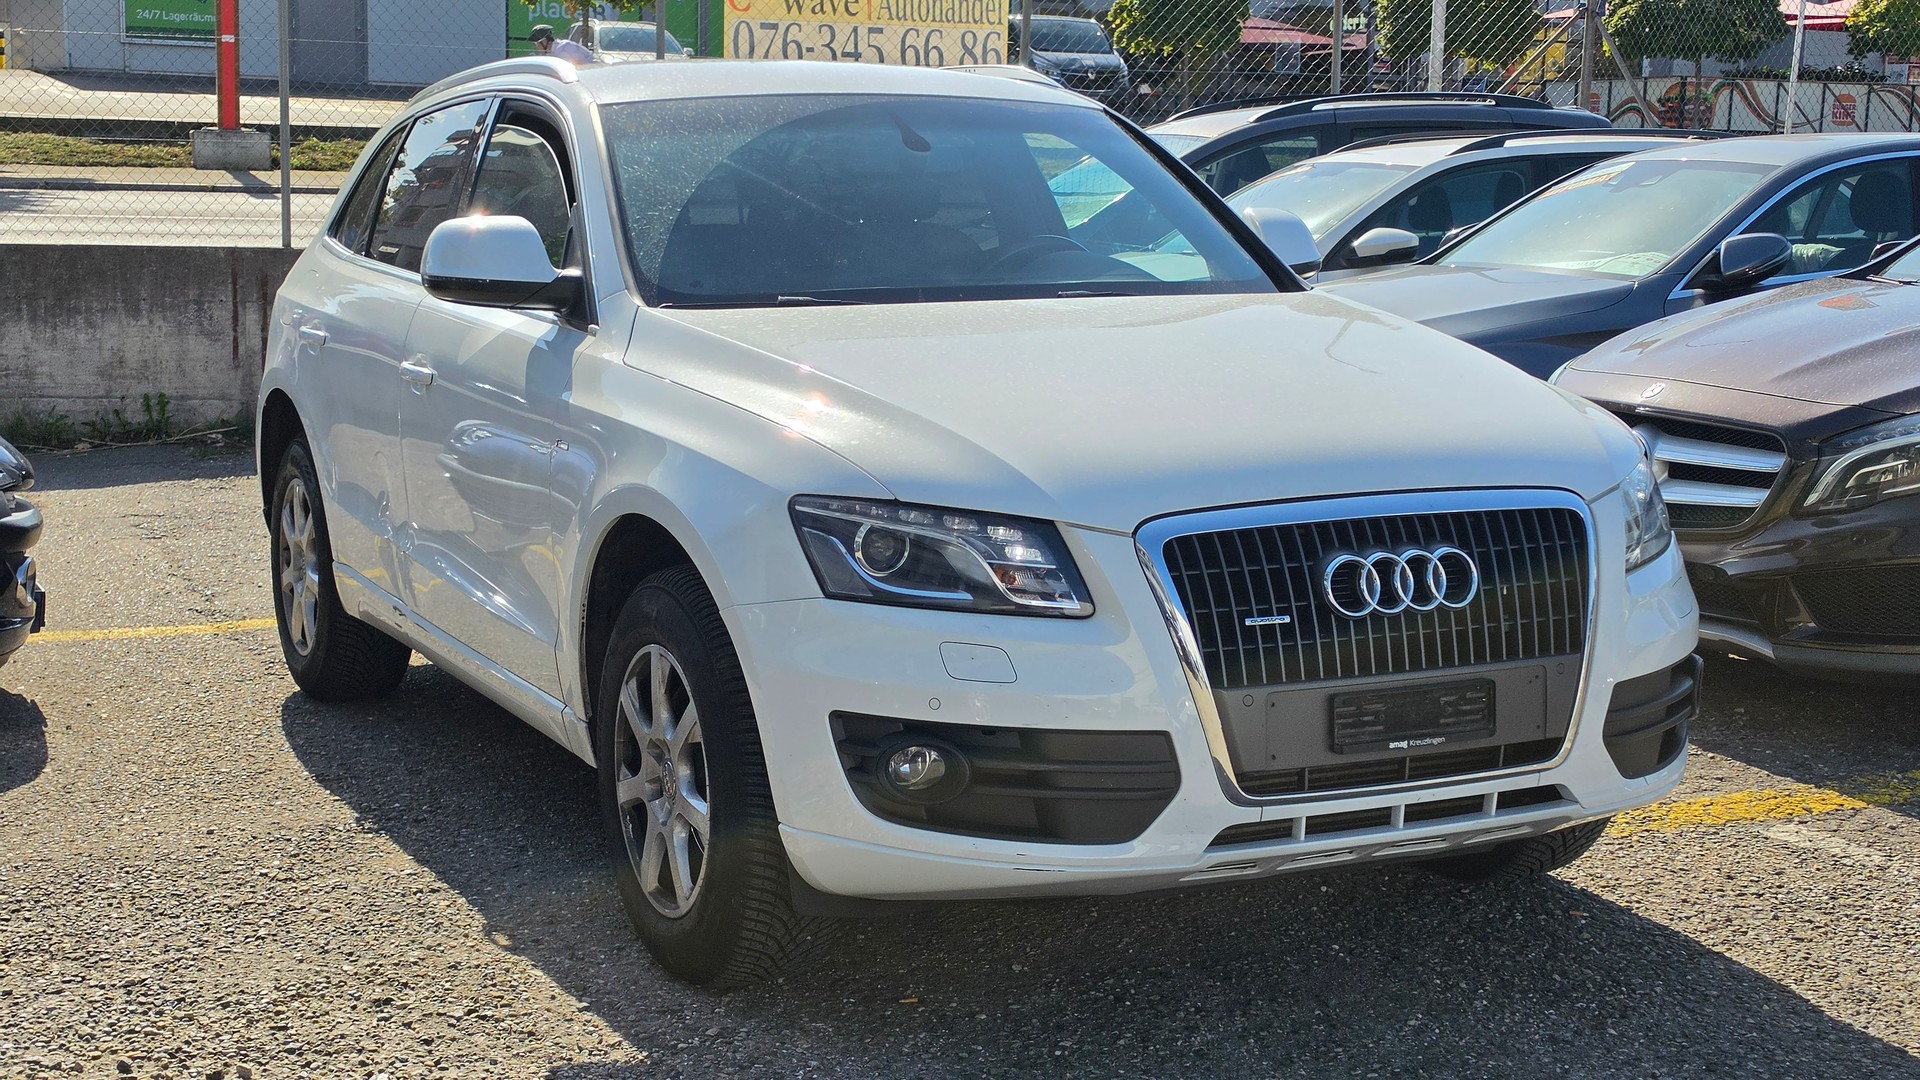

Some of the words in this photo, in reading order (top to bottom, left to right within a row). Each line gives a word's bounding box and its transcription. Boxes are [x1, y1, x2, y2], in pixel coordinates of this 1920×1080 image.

[136, 9, 160, 19] 24/7
[162, 11, 216, 22] Lagerräum
[877, 0, 1004, 26] Autohandel
[733, 20, 885, 64] 076-345
[900, 27, 944, 67] 66
[960, 30, 1002, 66] 86
[1832, 103, 1857, 111] BURGER
[1832, 111, 1856, 120] KING
[1389, 740, 1408, 748] amag
[1409, 737, 1445, 746] Kreuzlingen
